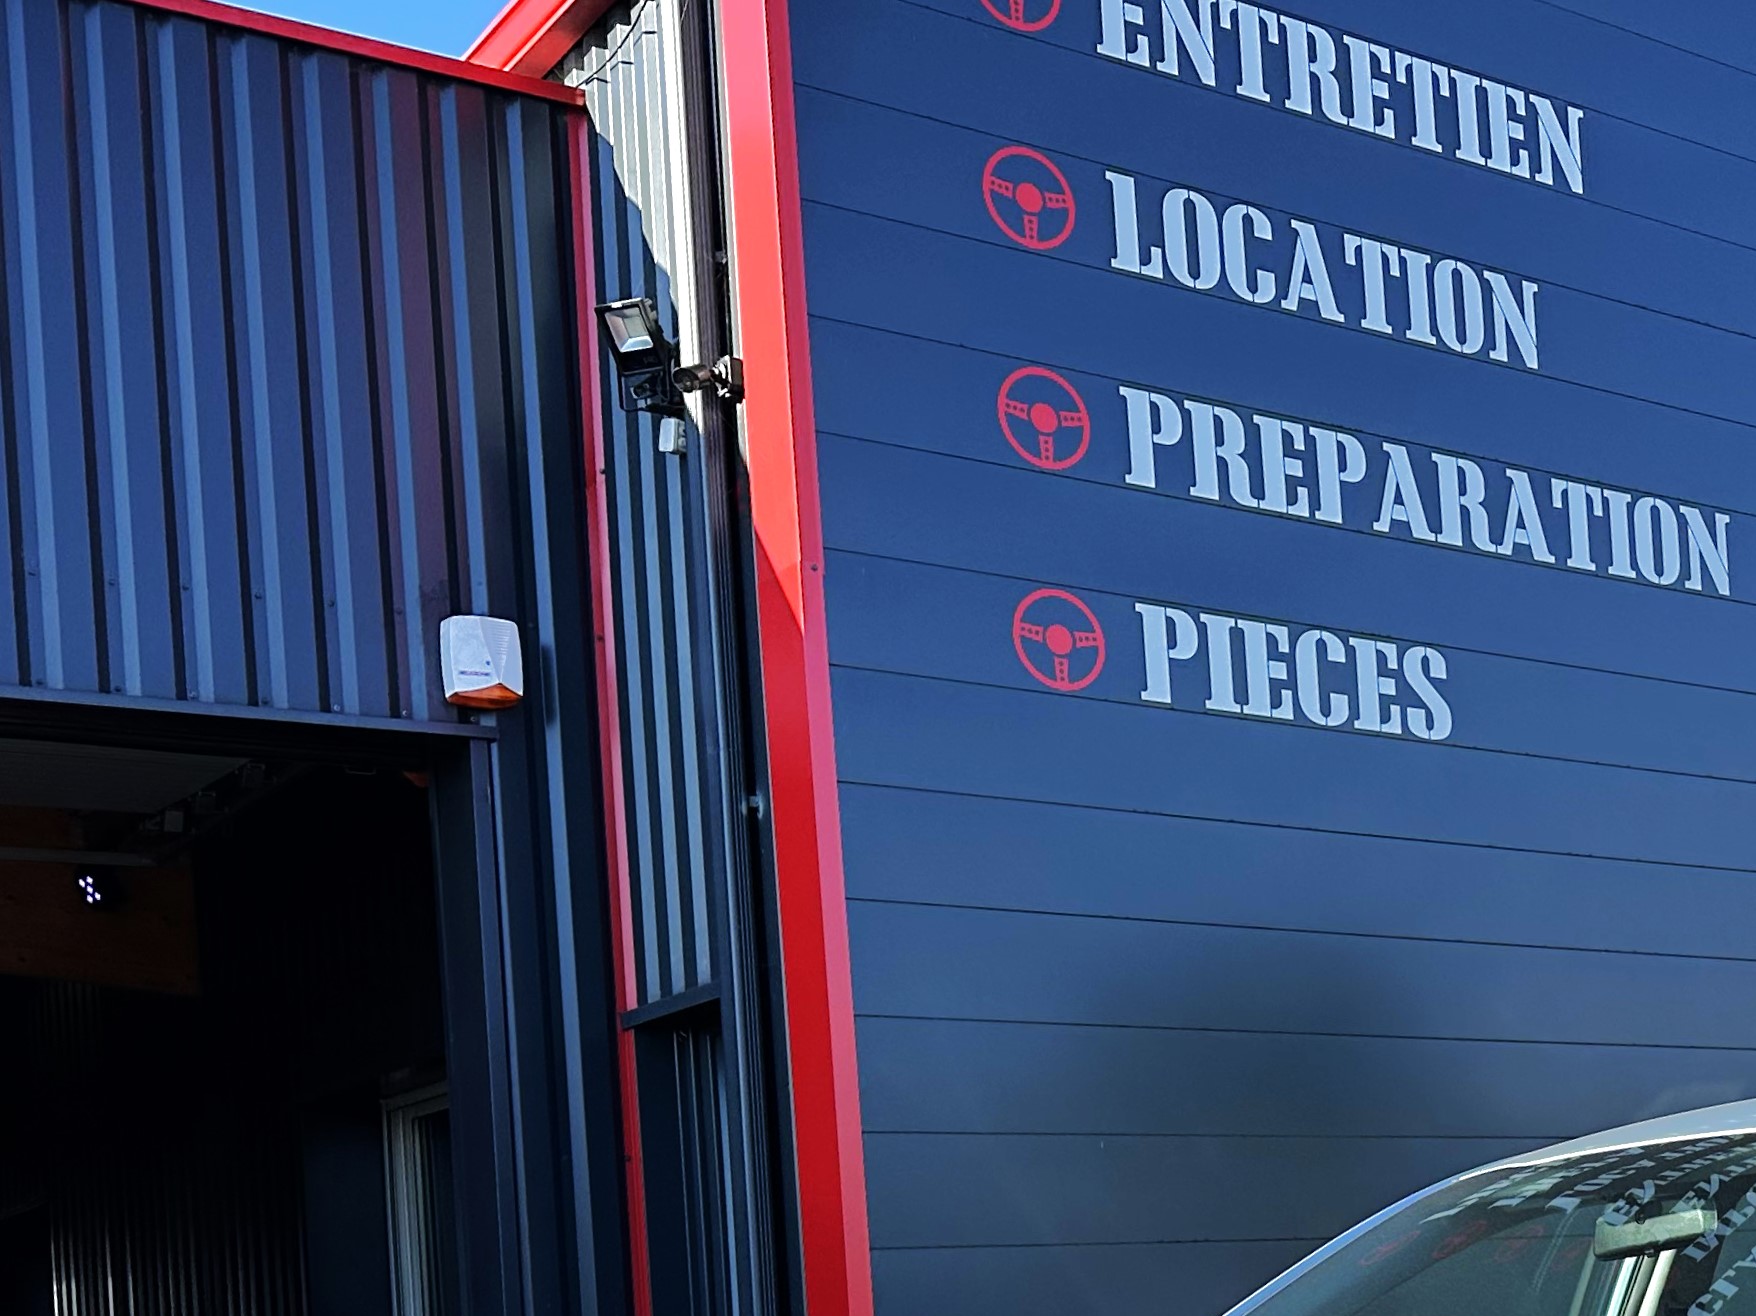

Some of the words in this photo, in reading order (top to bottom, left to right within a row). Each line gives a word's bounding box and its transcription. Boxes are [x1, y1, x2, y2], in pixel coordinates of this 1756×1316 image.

[1096, 0, 1585, 195] ENTRETIEN
[1105, 170, 1539, 370] LOCATION
[1119, 385, 1731, 597] PREPARATION
[1135, 601, 1453, 742] PIECES
